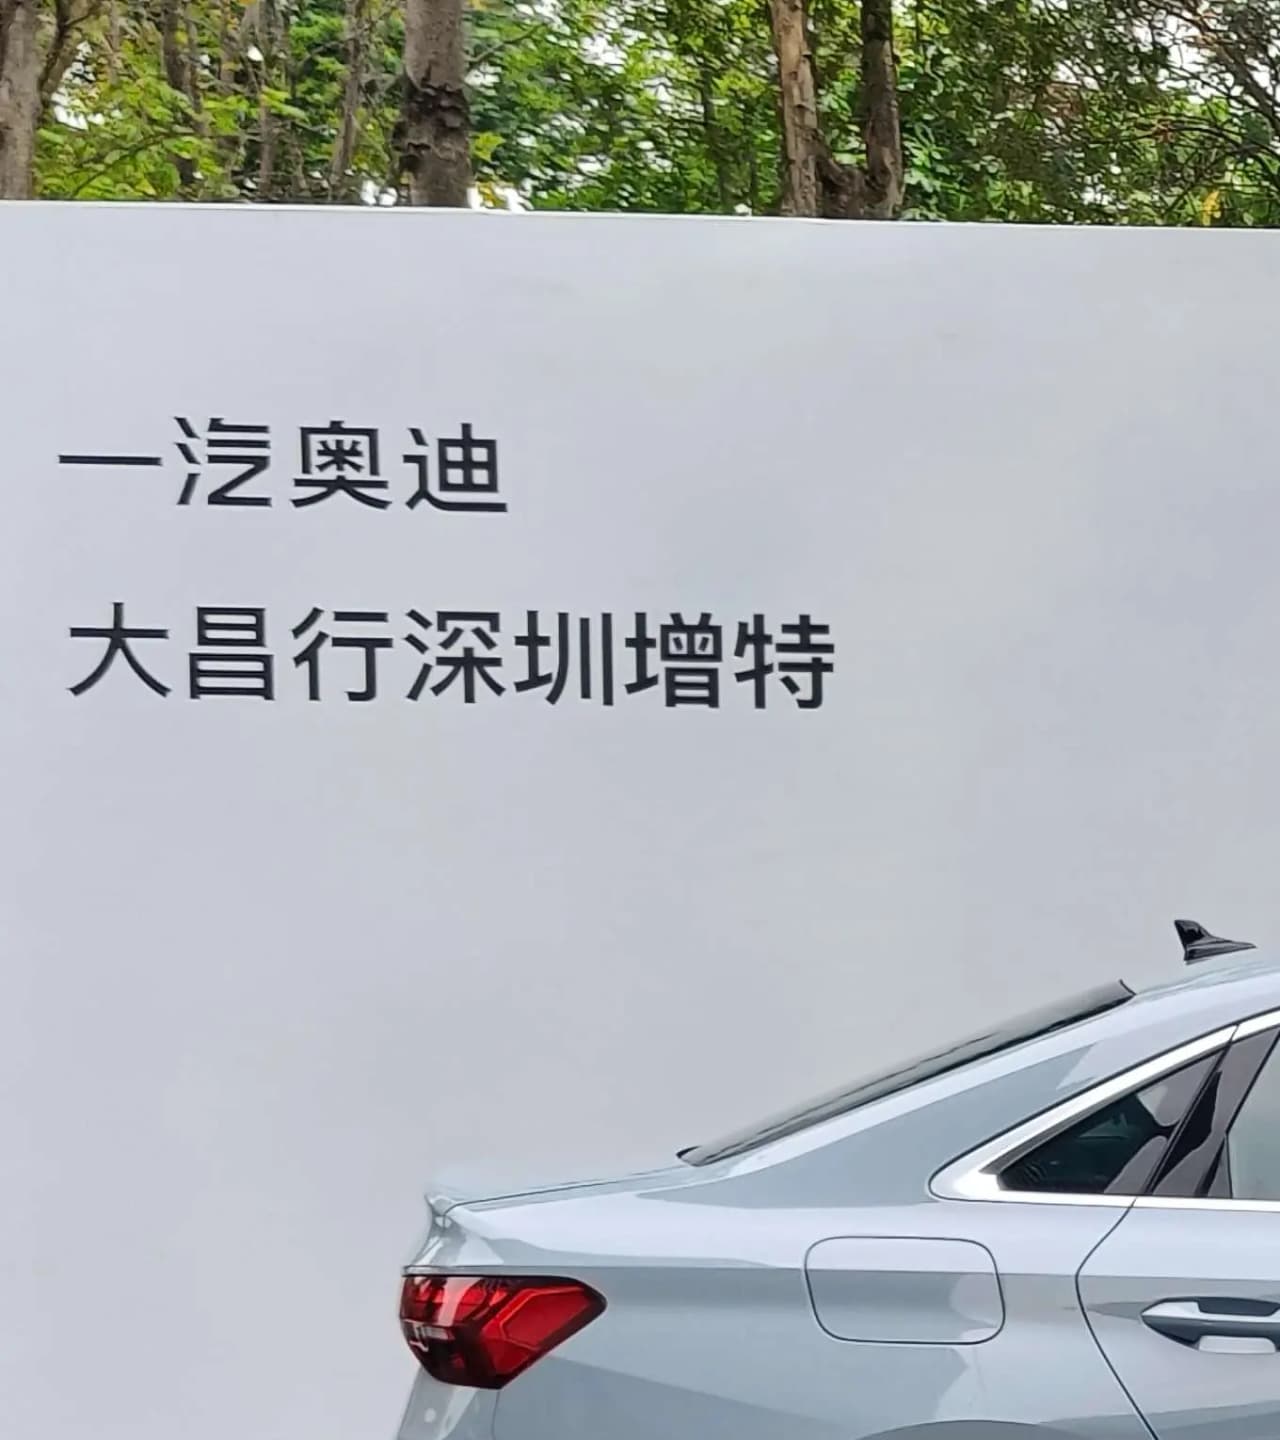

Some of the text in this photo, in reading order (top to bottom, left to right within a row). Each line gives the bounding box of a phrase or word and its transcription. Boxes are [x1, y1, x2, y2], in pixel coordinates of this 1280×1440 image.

[58, 416, 508, 513] 一汽奥迪
[67, 601, 836, 710] 大昌行深圳增特
